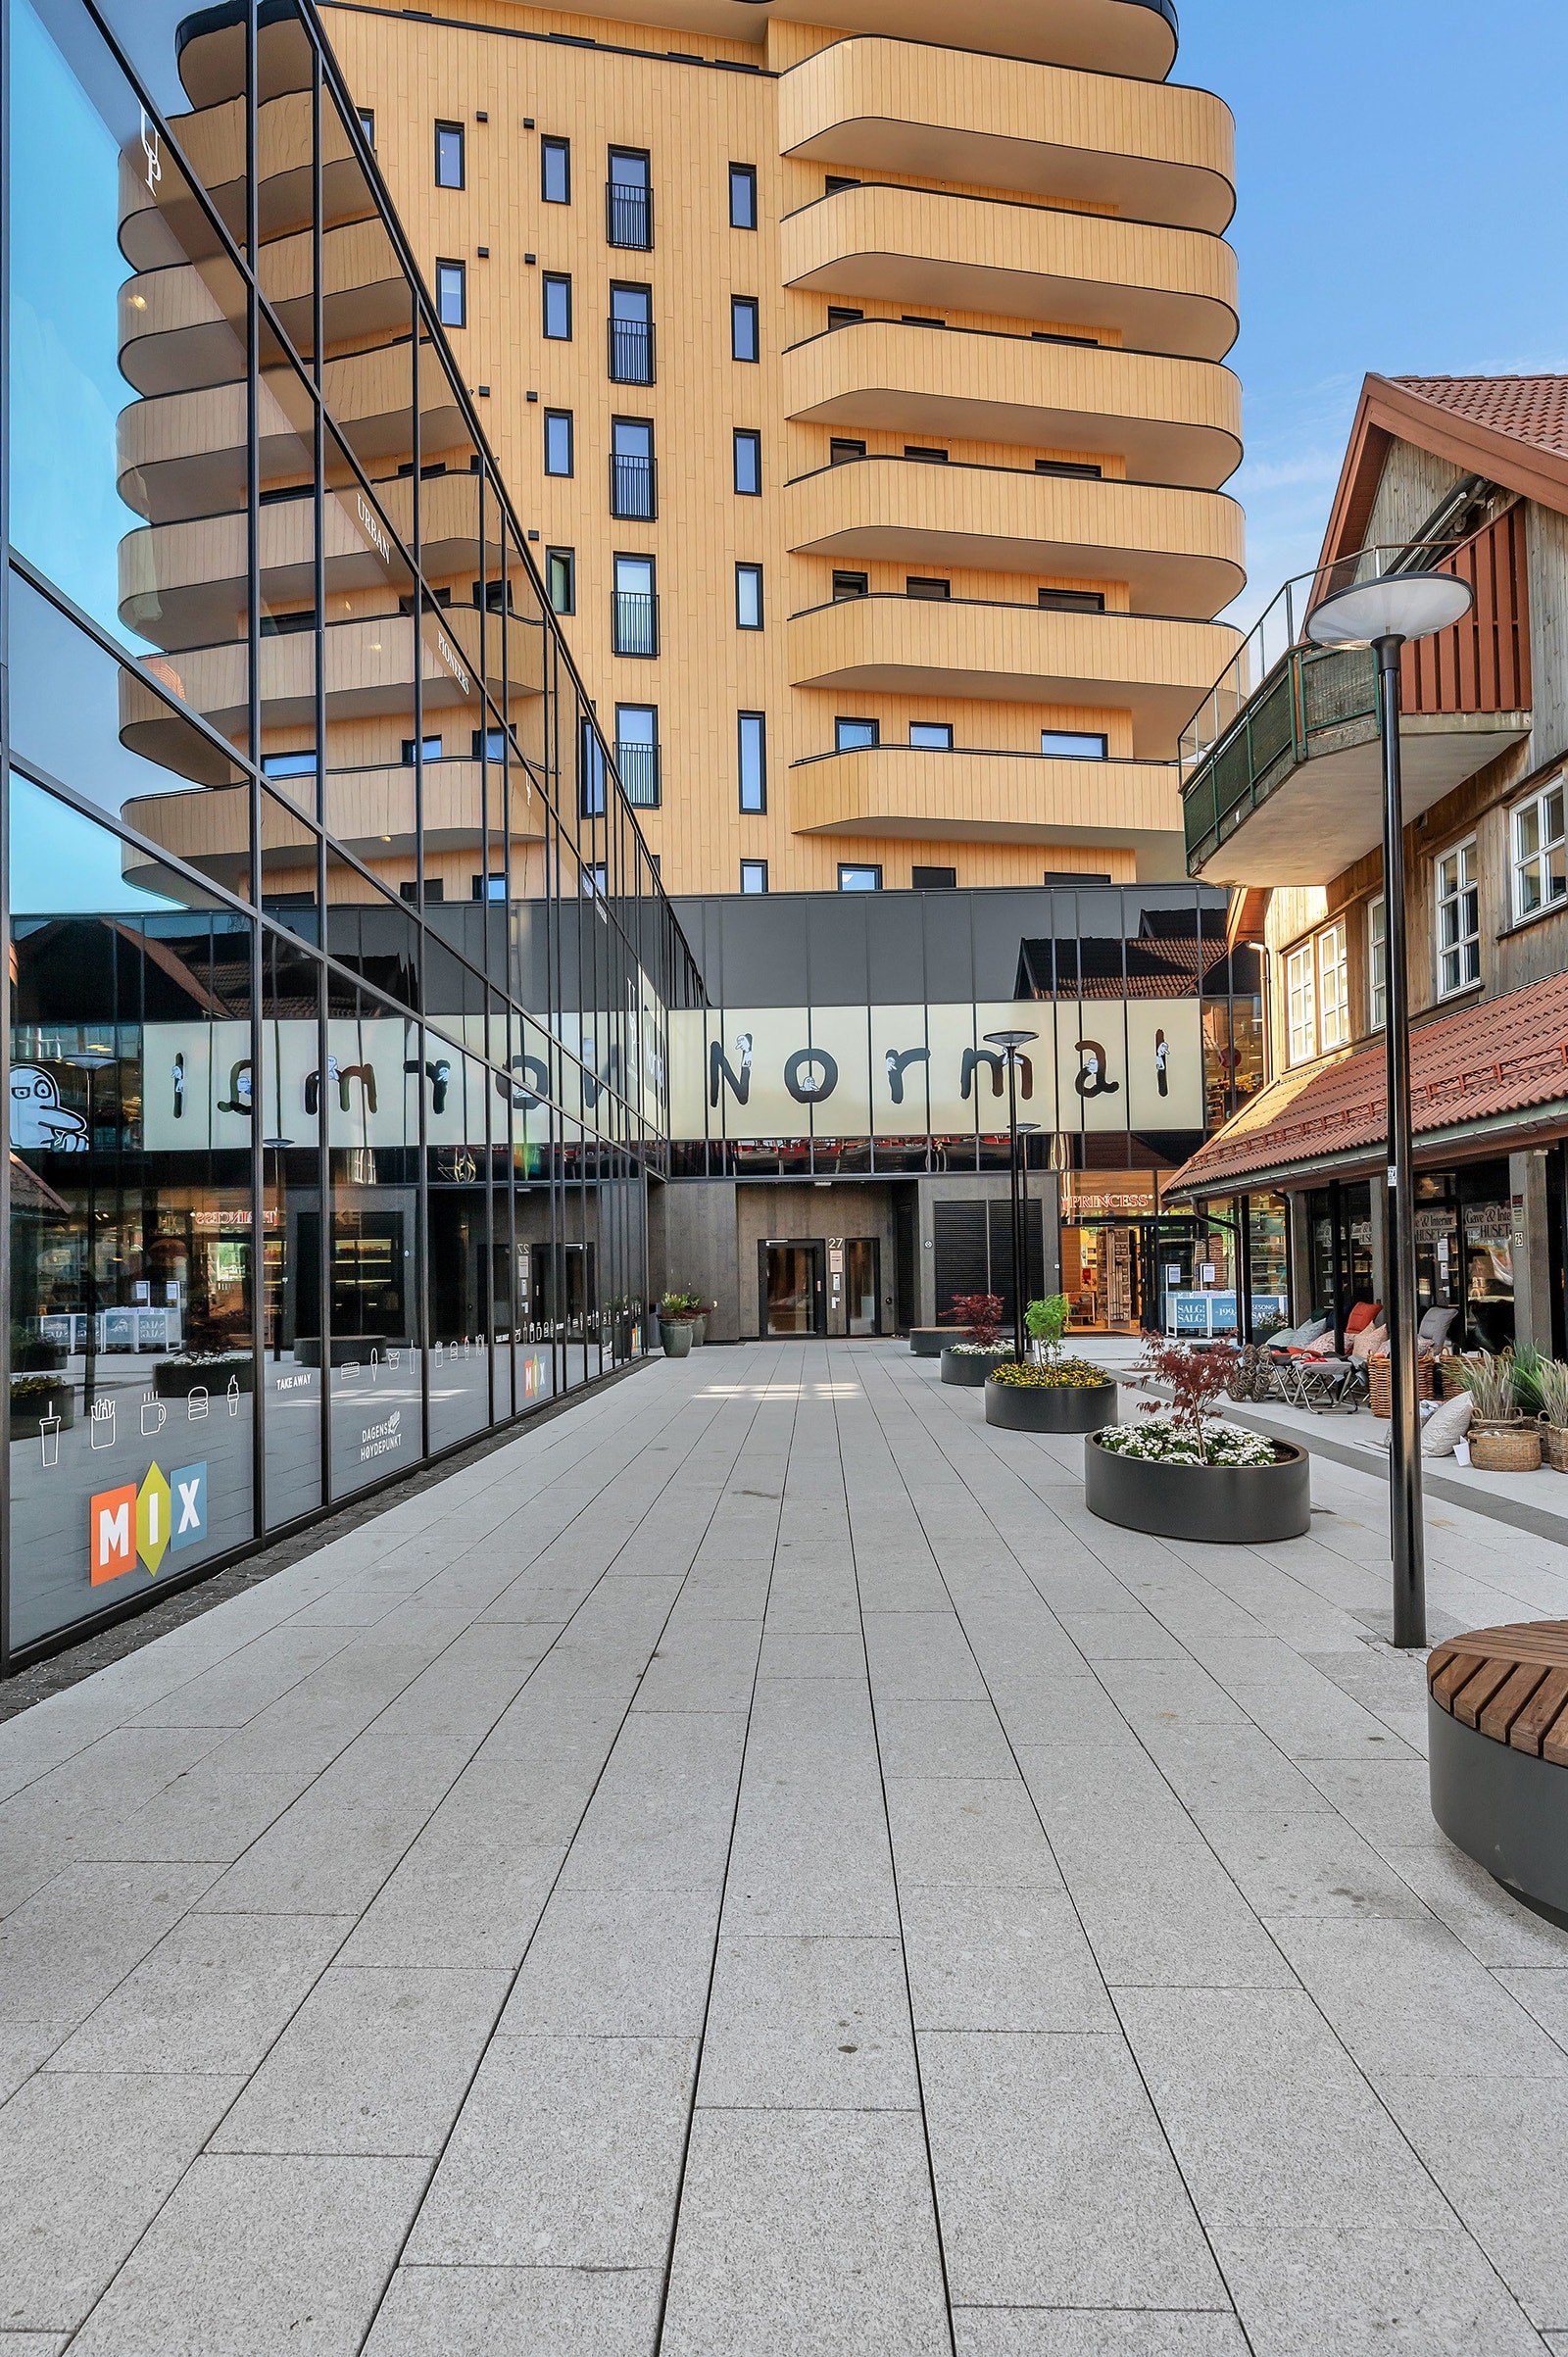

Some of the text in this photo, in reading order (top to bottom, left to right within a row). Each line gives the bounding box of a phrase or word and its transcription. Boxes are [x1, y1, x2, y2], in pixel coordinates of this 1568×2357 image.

[356, 493, 469, 695] URBAN PIONEERS
[710, 1028, 1169, 1107] Normal
[1481, 1224, 1510, 1238] HUSET
[1515, 1233, 1523, 1245] 25
[828, 1238, 843, 1249] 27
[1178, 1304, 1205, 1313] SALG!
[1178, 1314, 1205, 1323] SALG!
[276, 1374, 312, 1391] TAKE AWAY
[363, 1422, 387, 1443] DAGENS
[360, 1434, 401, 1460] HØYDEPUNKT
[99, 1478, 201, 1567] MIX
